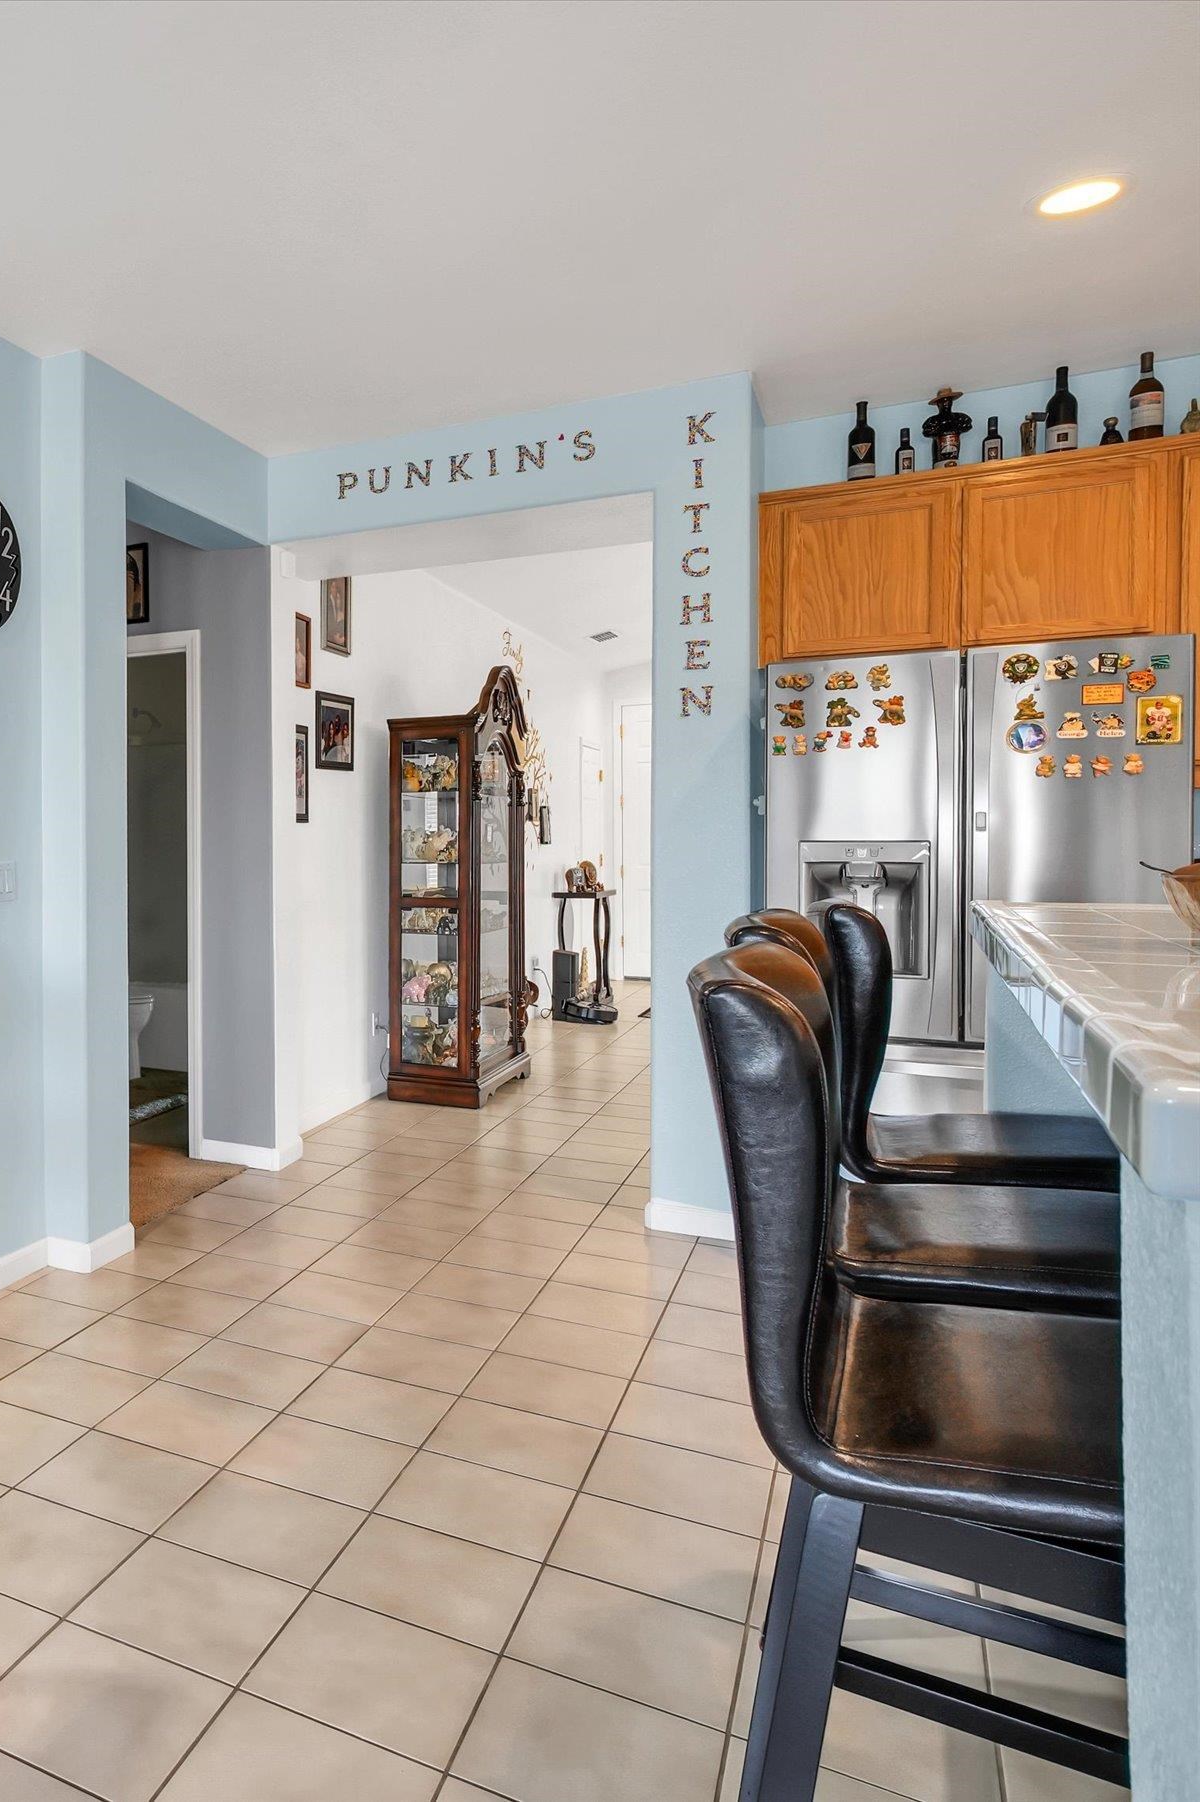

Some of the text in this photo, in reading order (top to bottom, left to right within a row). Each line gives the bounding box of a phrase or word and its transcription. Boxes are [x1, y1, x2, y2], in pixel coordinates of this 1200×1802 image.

[337, 430, 596, 500] PUNKIN'S
[1, 526, 14, 560] 2
[680, 411, 716, 718] KITCHEN
